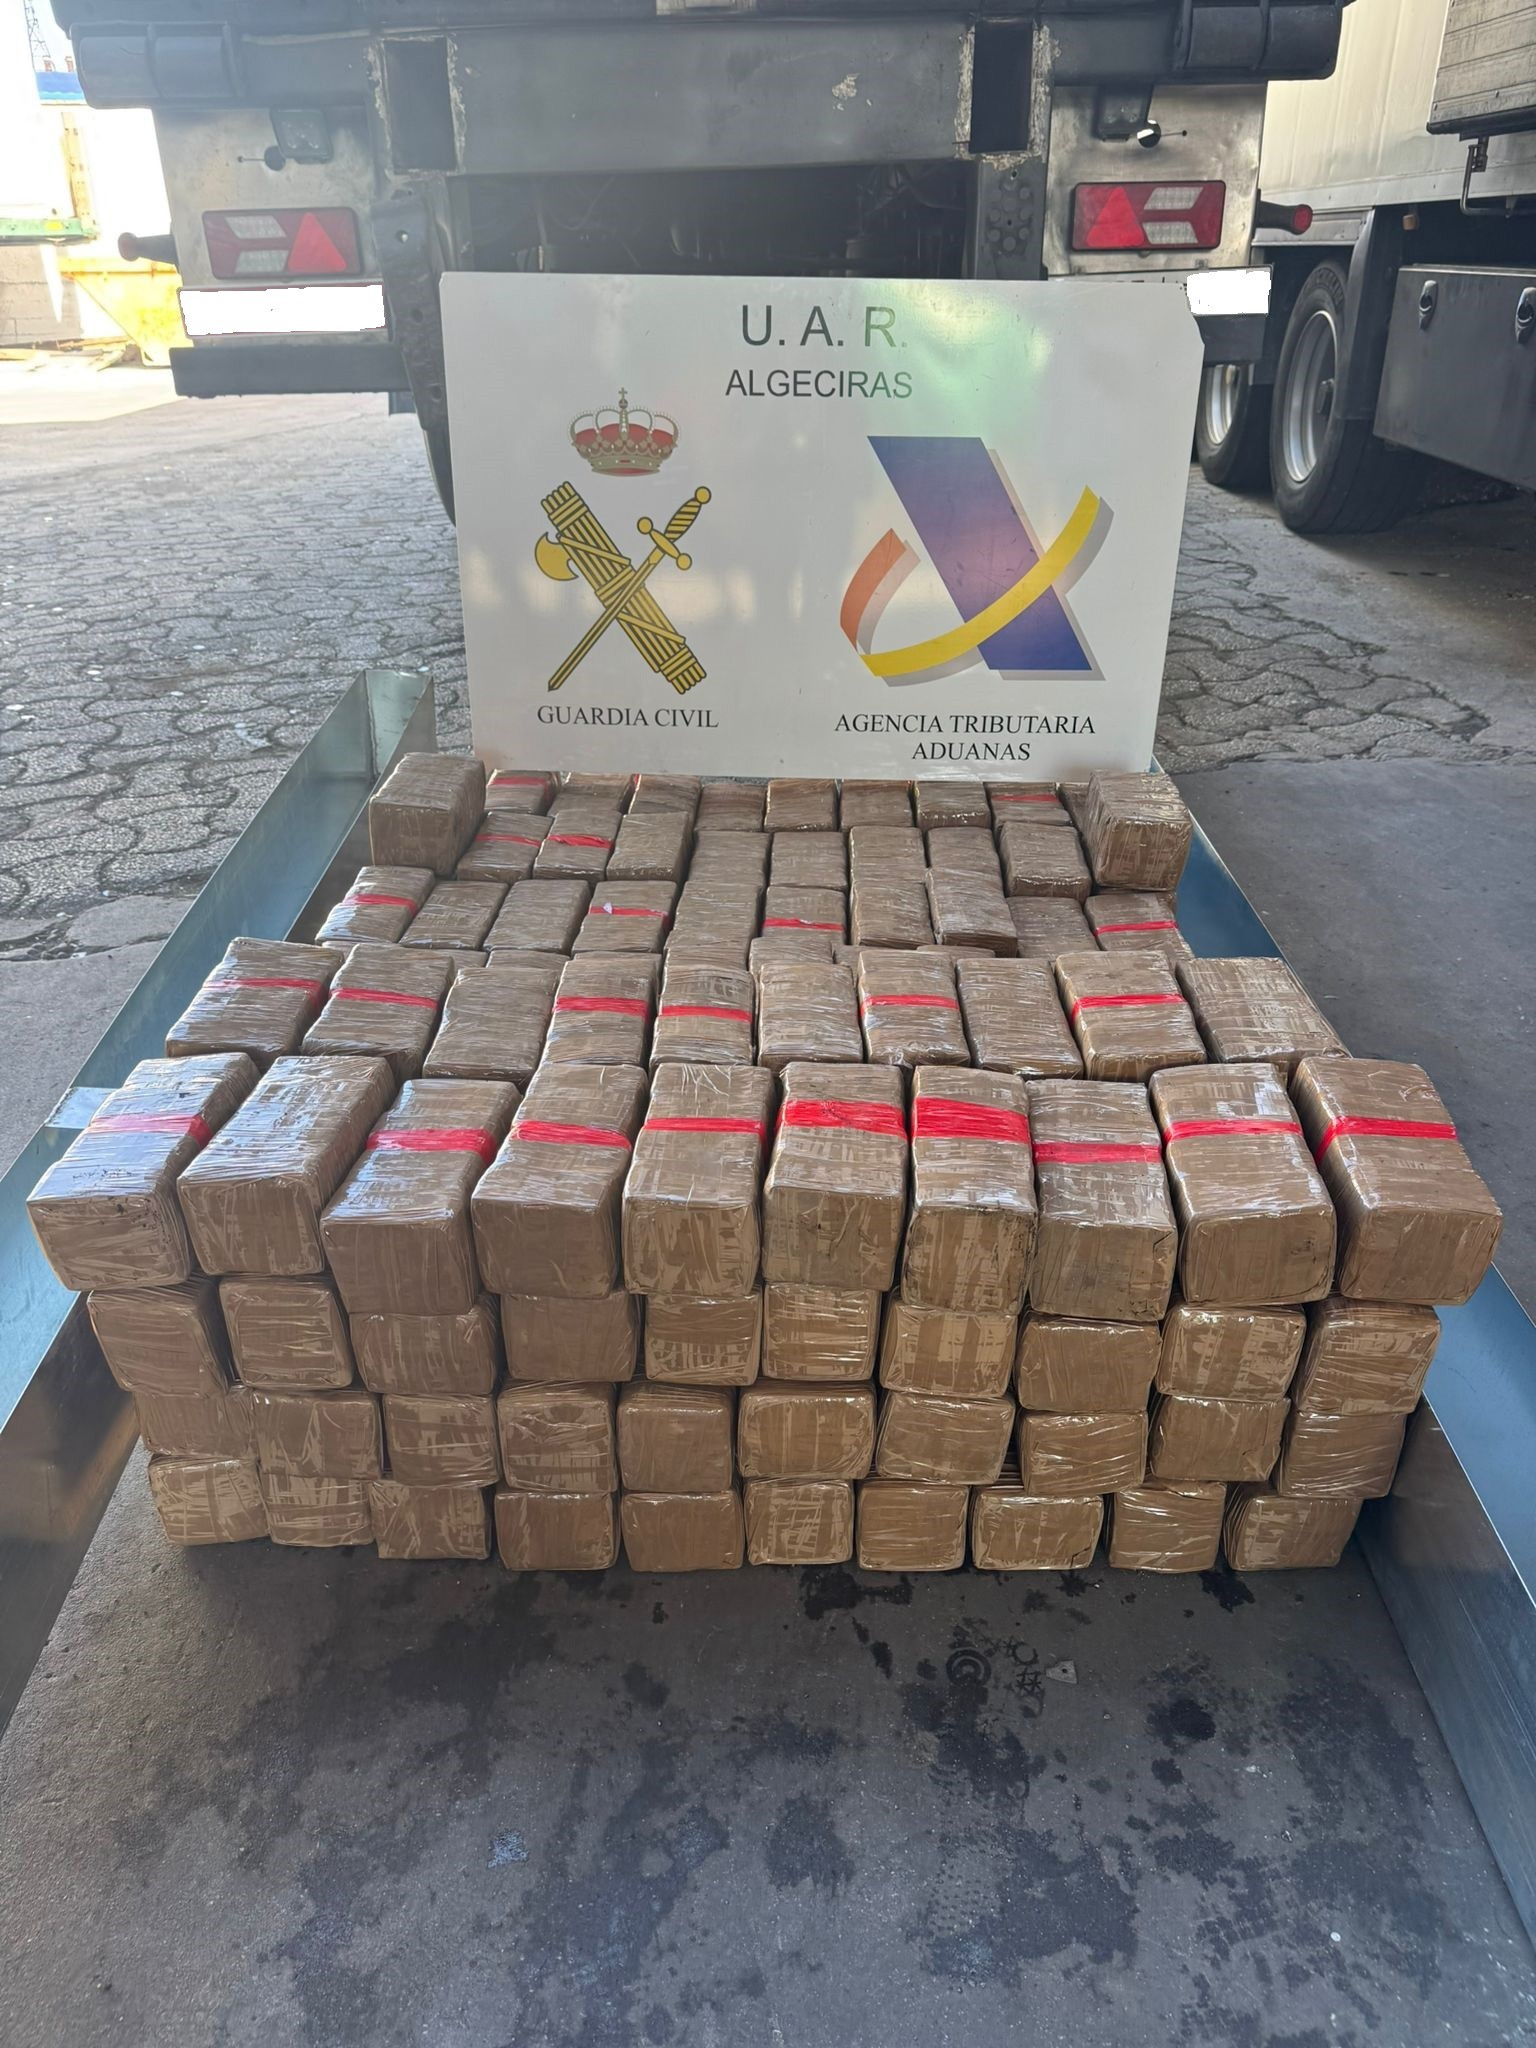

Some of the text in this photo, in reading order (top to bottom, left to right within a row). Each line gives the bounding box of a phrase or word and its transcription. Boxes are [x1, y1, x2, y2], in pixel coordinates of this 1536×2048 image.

[742, 305, 909, 348] U. A. R.
[724, 368, 913, 399] ALGECIRAS
[537, 705, 720, 728] GUARDIA CIVIL
[834, 713, 1096, 735] AGENCIA TRIBUTARIA
[911, 741, 1031, 762] ADUANAS
